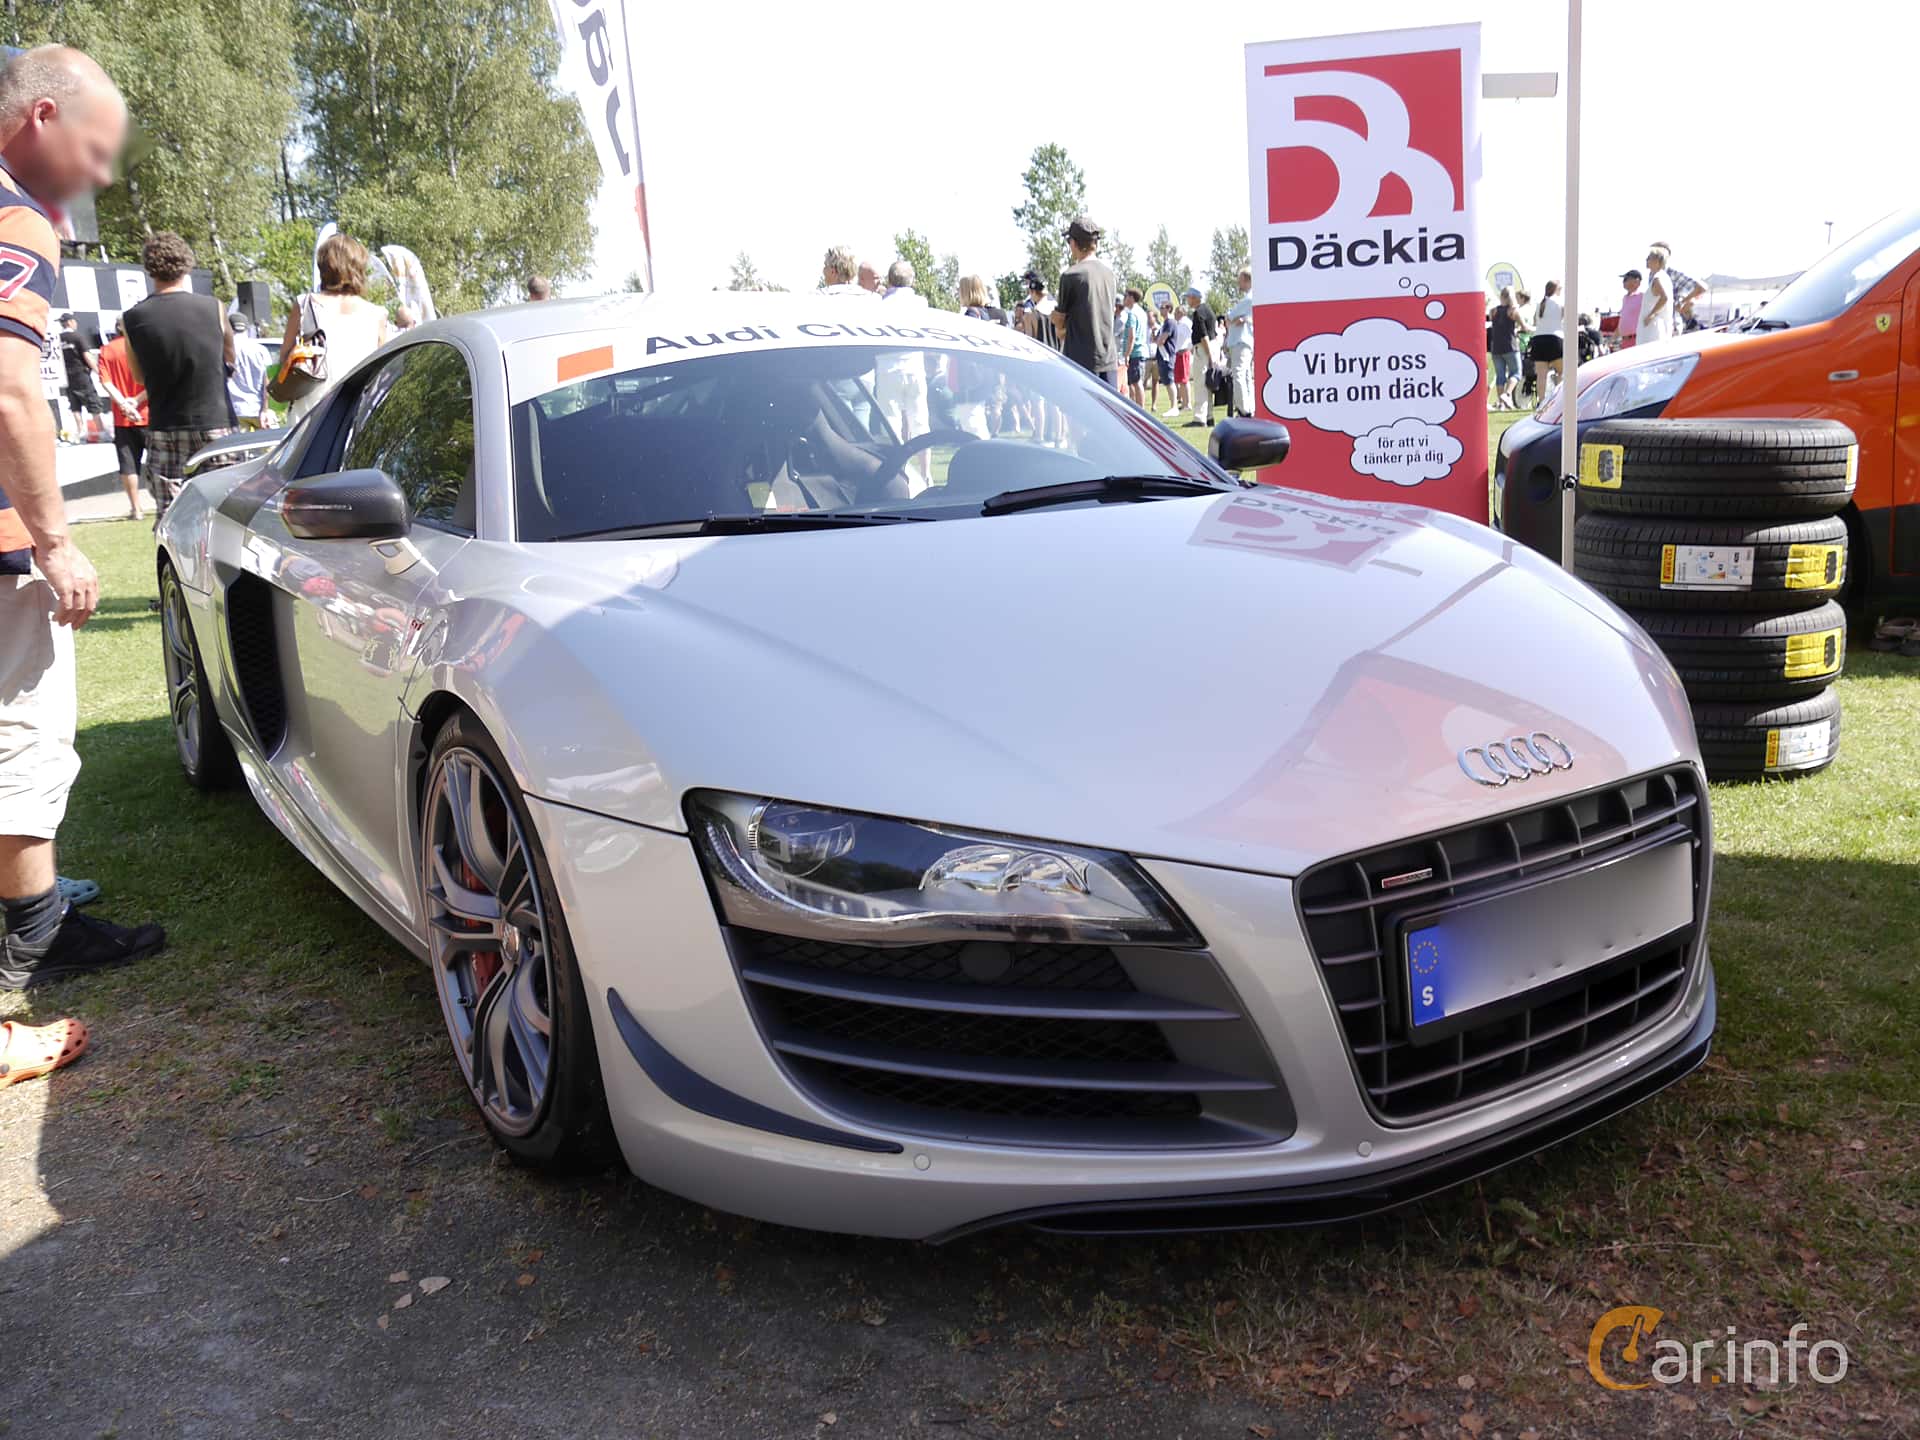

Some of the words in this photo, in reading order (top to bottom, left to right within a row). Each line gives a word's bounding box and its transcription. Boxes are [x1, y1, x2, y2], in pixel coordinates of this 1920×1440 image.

[1268, 227, 1465, 272] Däckia
[646, 325, 781, 355] Audi
[1304, 353, 1326, 376] Vi
[1334, 352, 1381, 378] bryr
[1387, 353, 1427, 371] oss
[1288, 383, 1339, 405] bara
[1347, 383, 1380, 401] om
[1389, 376, 1445, 399] däck
[1378, 437, 1394, 449] för
[1398, 436, 1414, 448] att
[1418, 435, 1429, 447] vi
[1364, 451, 1402, 465] tänker
[1406, 451, 1421, 466] på
[1425, 450, 1444, 464] dig
[1421, 985, 1435, 1006] S
